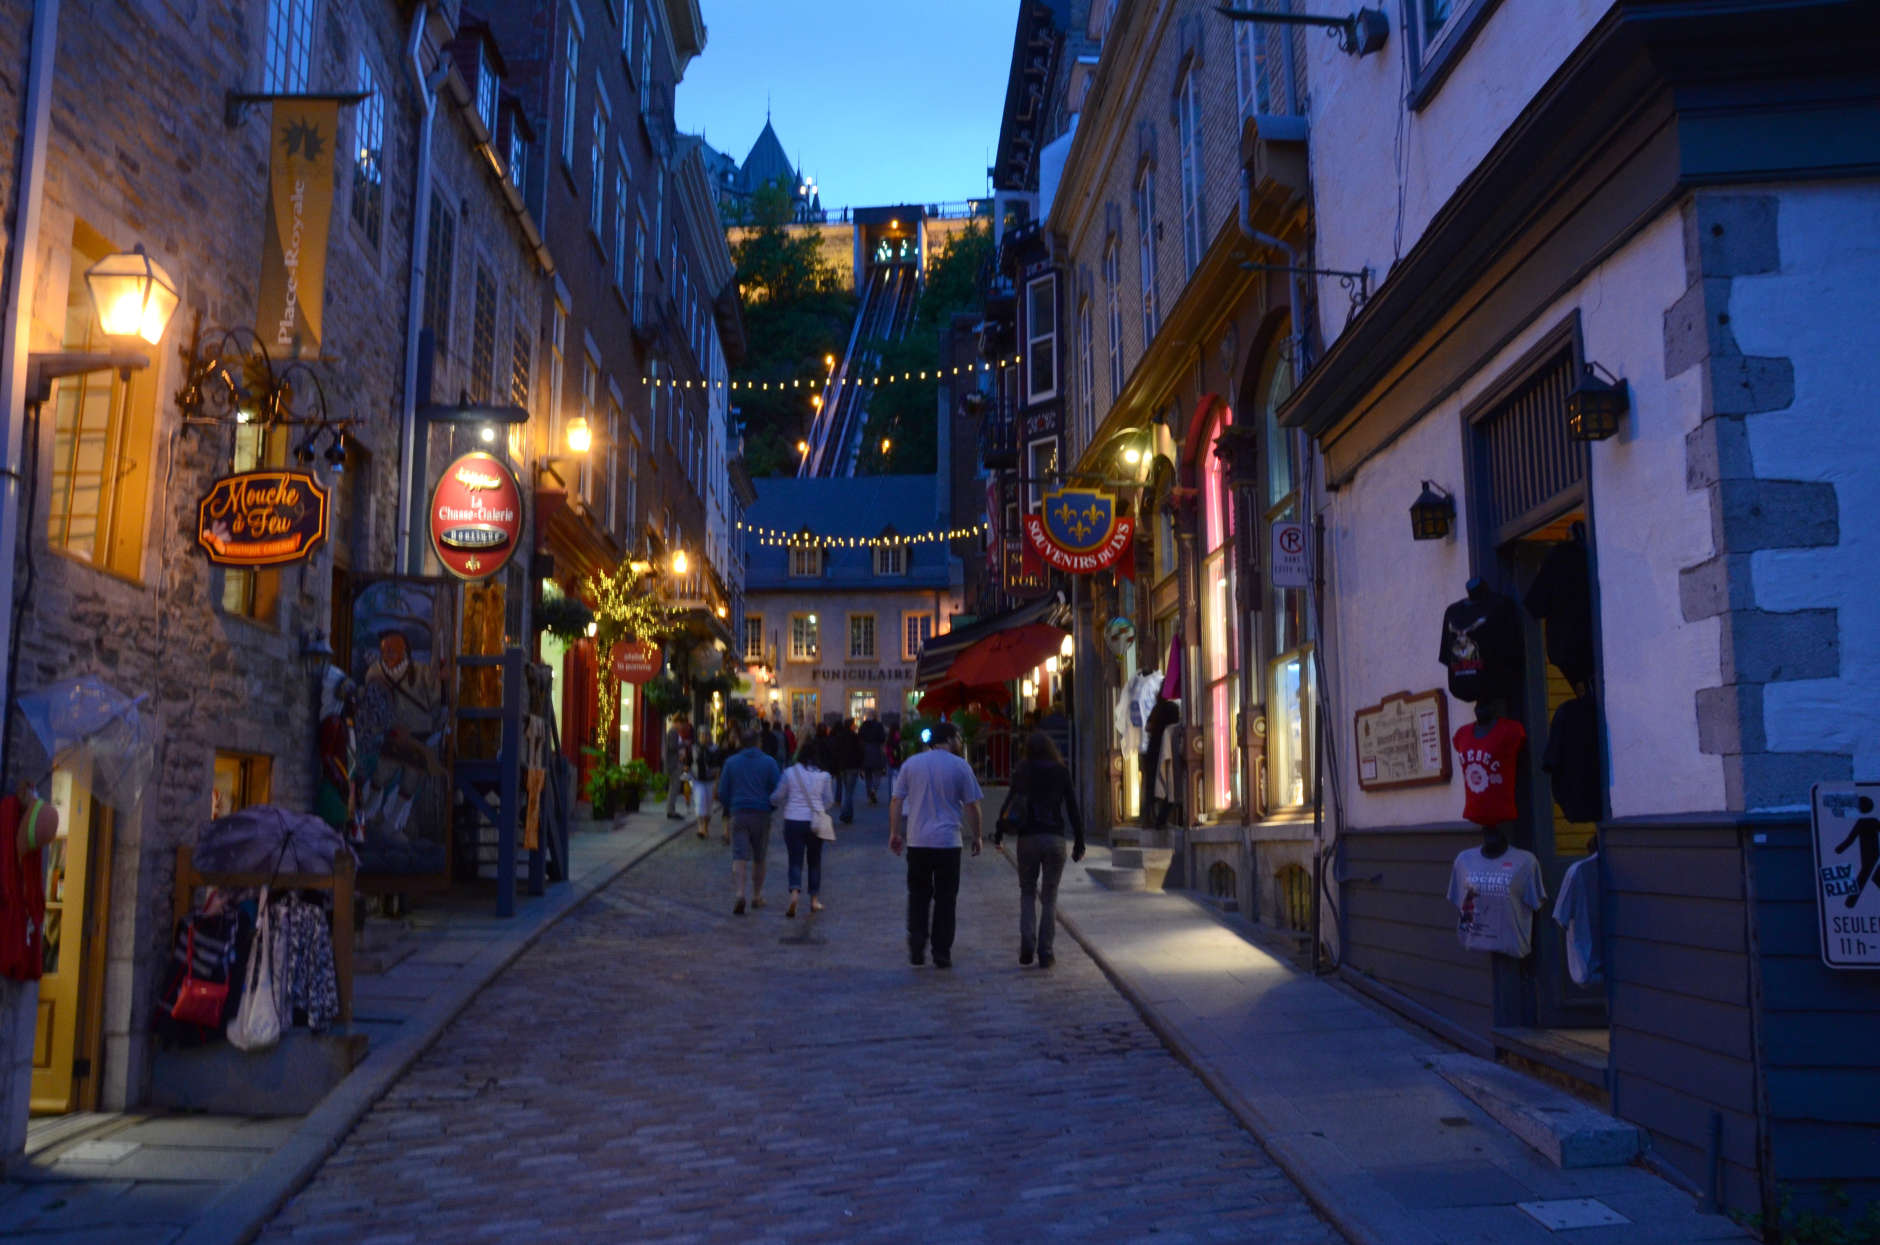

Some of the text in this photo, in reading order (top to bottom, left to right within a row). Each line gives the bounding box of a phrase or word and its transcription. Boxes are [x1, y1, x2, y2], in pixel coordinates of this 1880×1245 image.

[278, 180, 305, 345] Place-Royale
[211, 472, 299, 518] Mouche
[1028, 520, 1098, 569] SOUVENIRS
[1097, 545, 1115, 564] DU
[1111, 522, 1130, 551] LYS
[812, 669, 913, 680] FUNICULAIRE
[1833, 916, 1880, 934] SEULE
